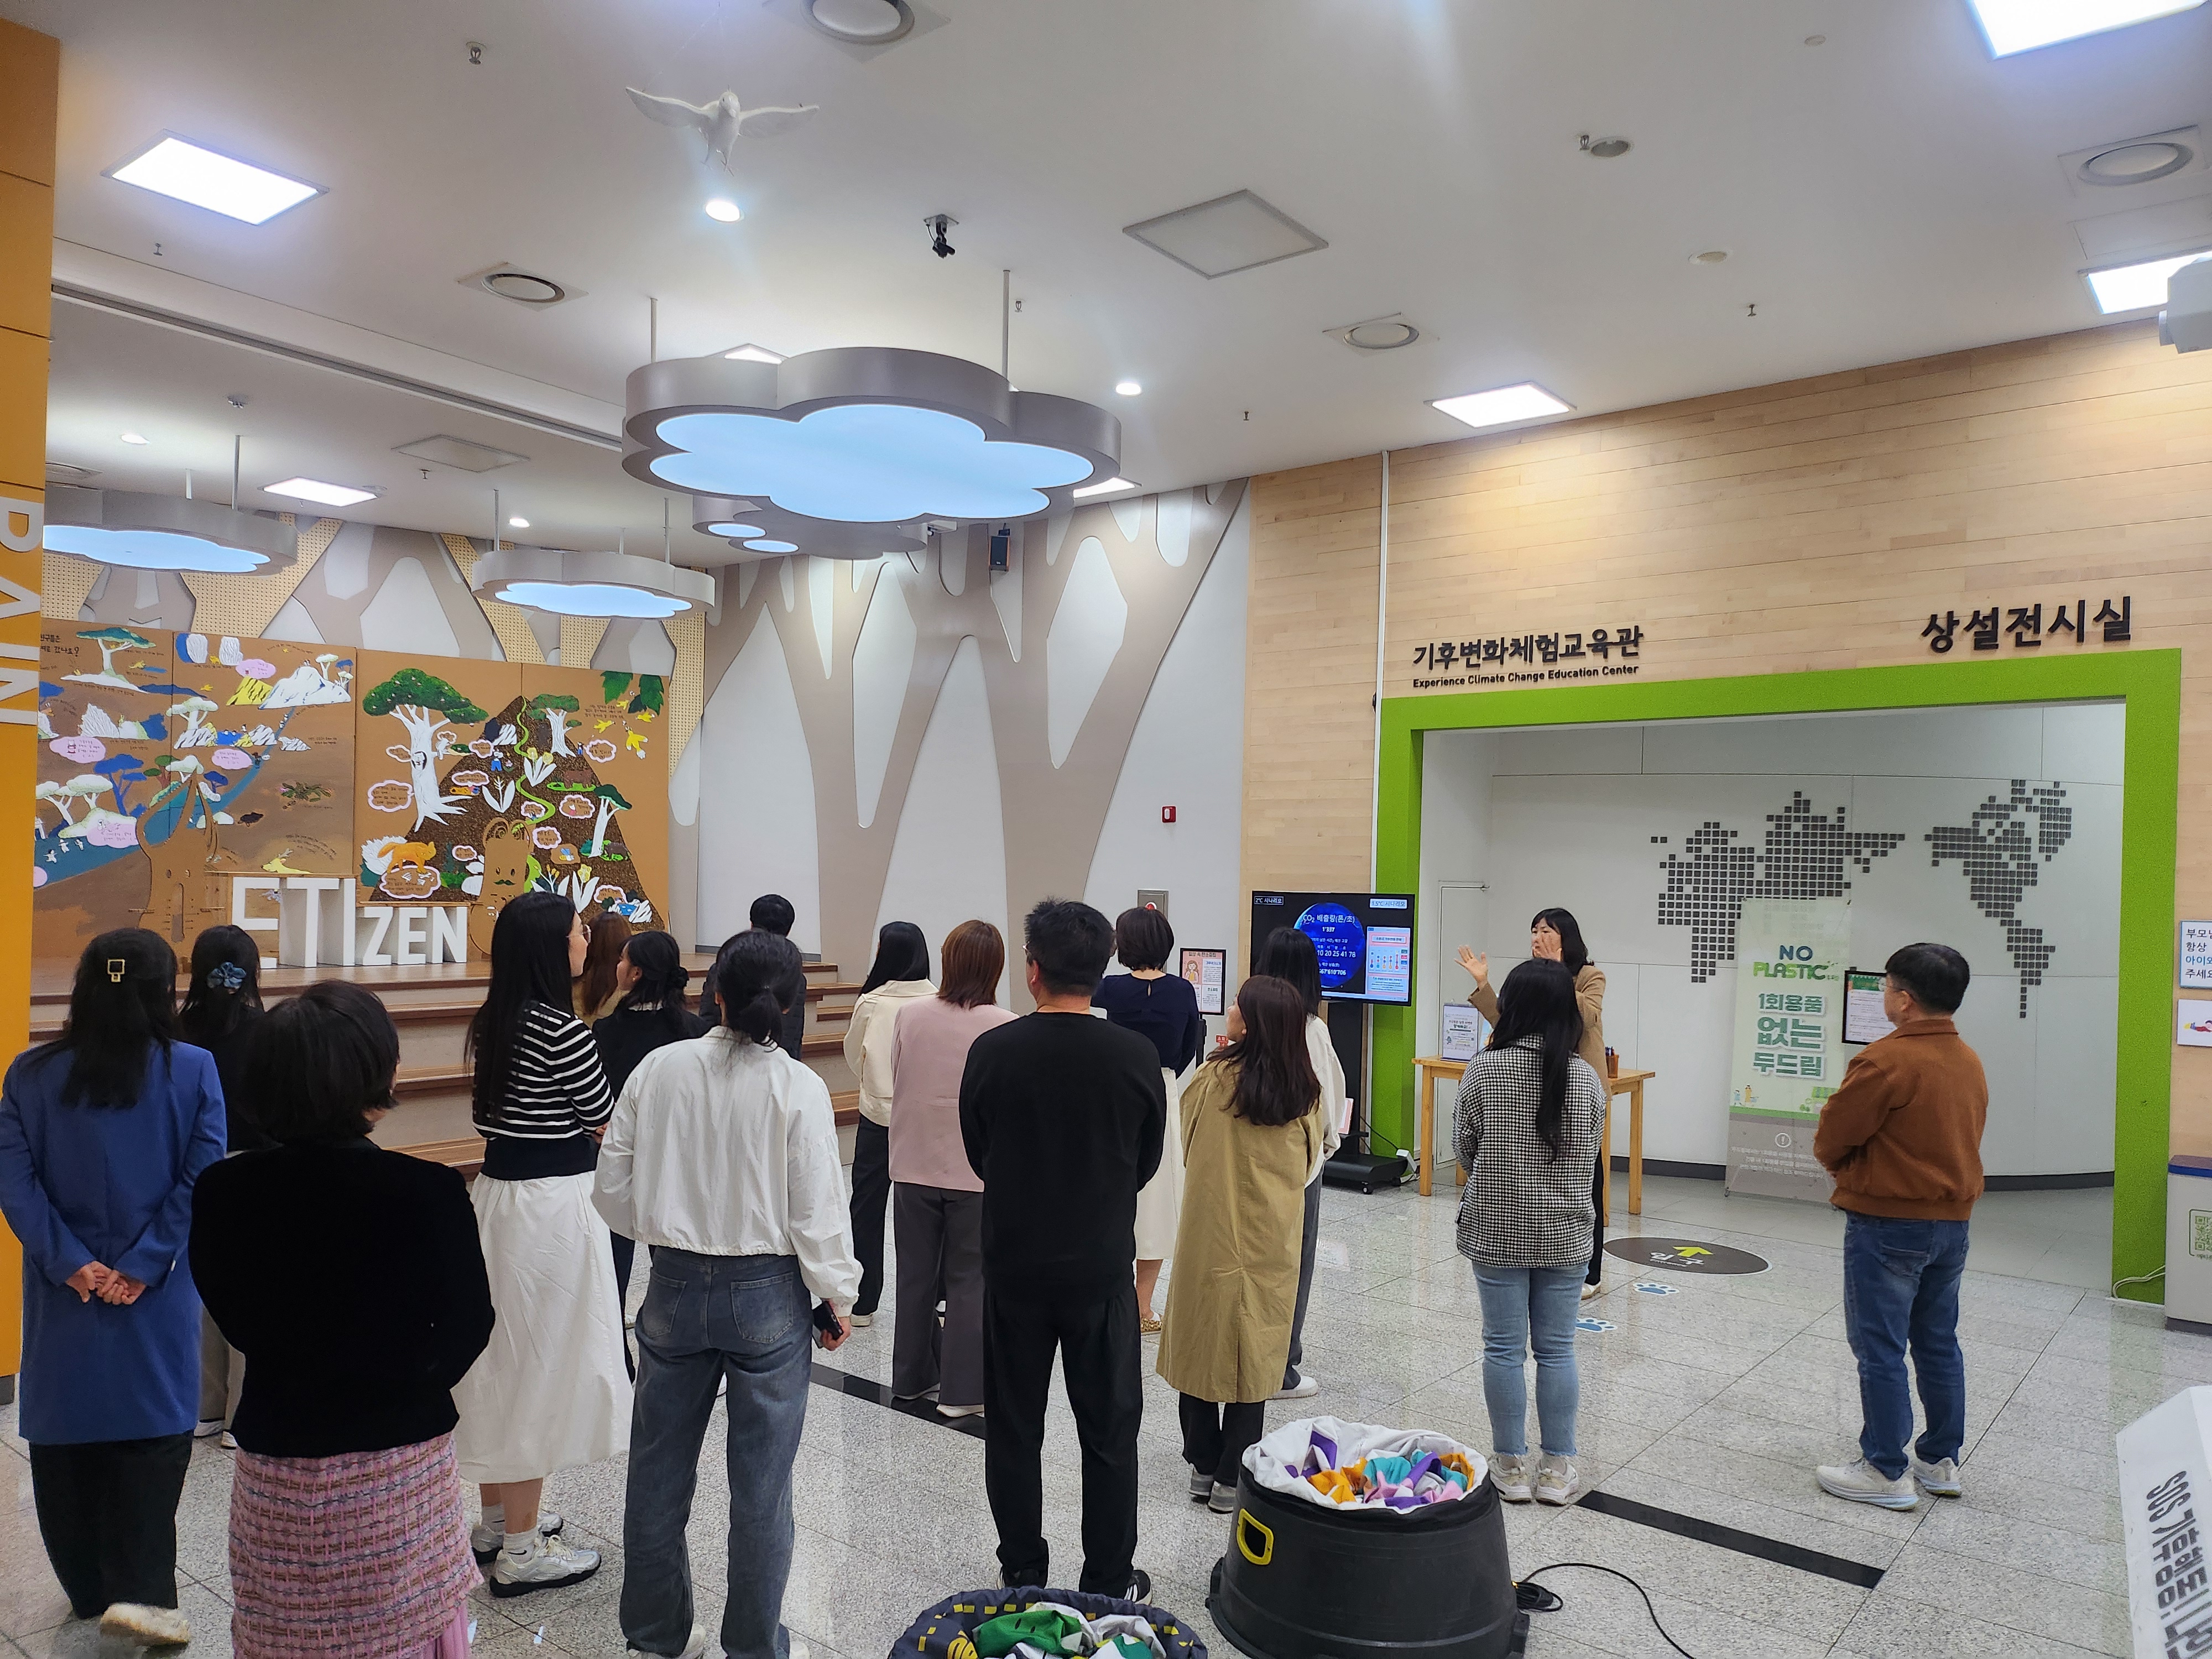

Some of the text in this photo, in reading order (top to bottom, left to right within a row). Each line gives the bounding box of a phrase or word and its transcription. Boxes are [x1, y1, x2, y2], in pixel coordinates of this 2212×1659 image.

[1922, 596, 2131, 653] 상설전시실
[1413, 625, 1643, 670] 기후변화체험교육관
[1413, 665, 1639, 688] Experience Climate Change Education Center
[1779, 945, 1813, 961] NO
[2186, 942, 2207, 952] 항상
[1753, 962, 1829, 980] PLASTIC
[1758, 993, 1822, 1013] 1회용품
[1757, 1016, 1822, 1049] 없는
[1753, 1052, 1822, 1077] 두드림
[2146, 1470, 2190, 1523] SOS
[2152, 1507, 2210, 1619] 기후행동!
